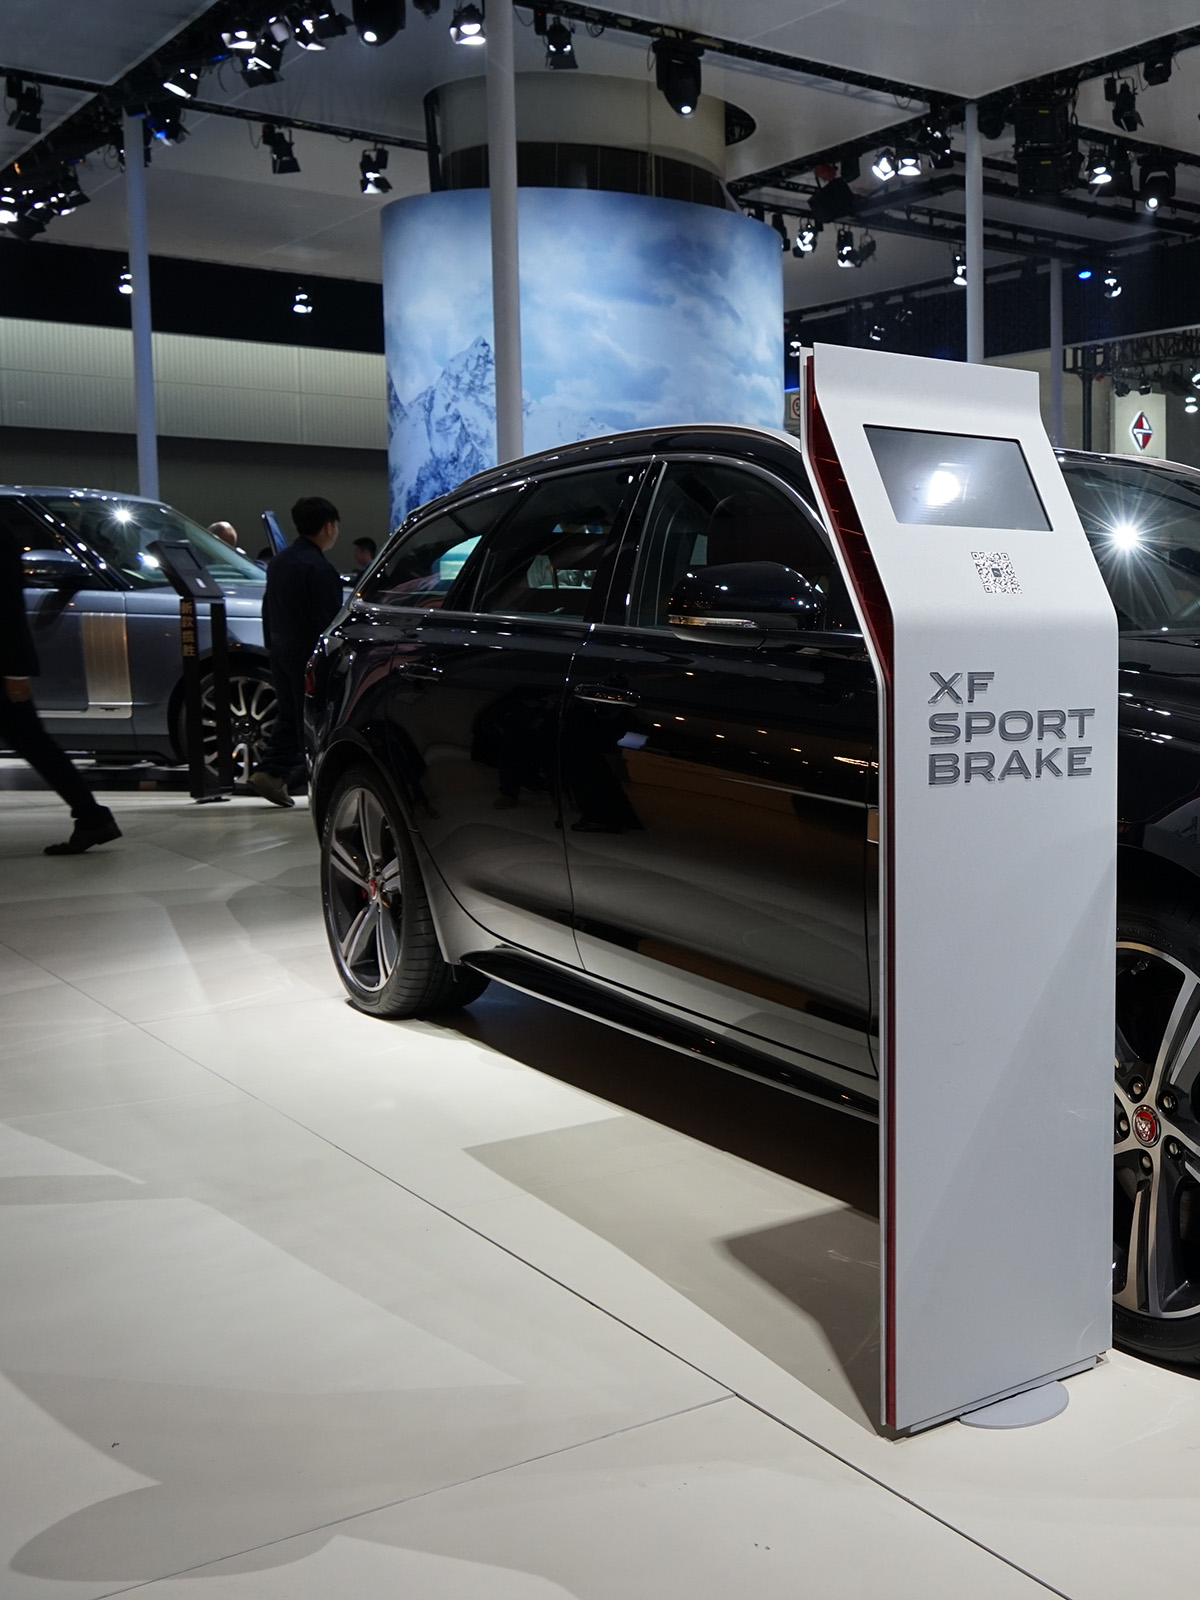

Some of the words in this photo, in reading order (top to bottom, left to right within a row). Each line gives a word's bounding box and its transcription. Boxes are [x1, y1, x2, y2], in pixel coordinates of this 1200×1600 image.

[928, 672, 995, 704] XF
[928, 708, 1096, 745] SPORT
[928, 746, 1093, 785] BRAKE
